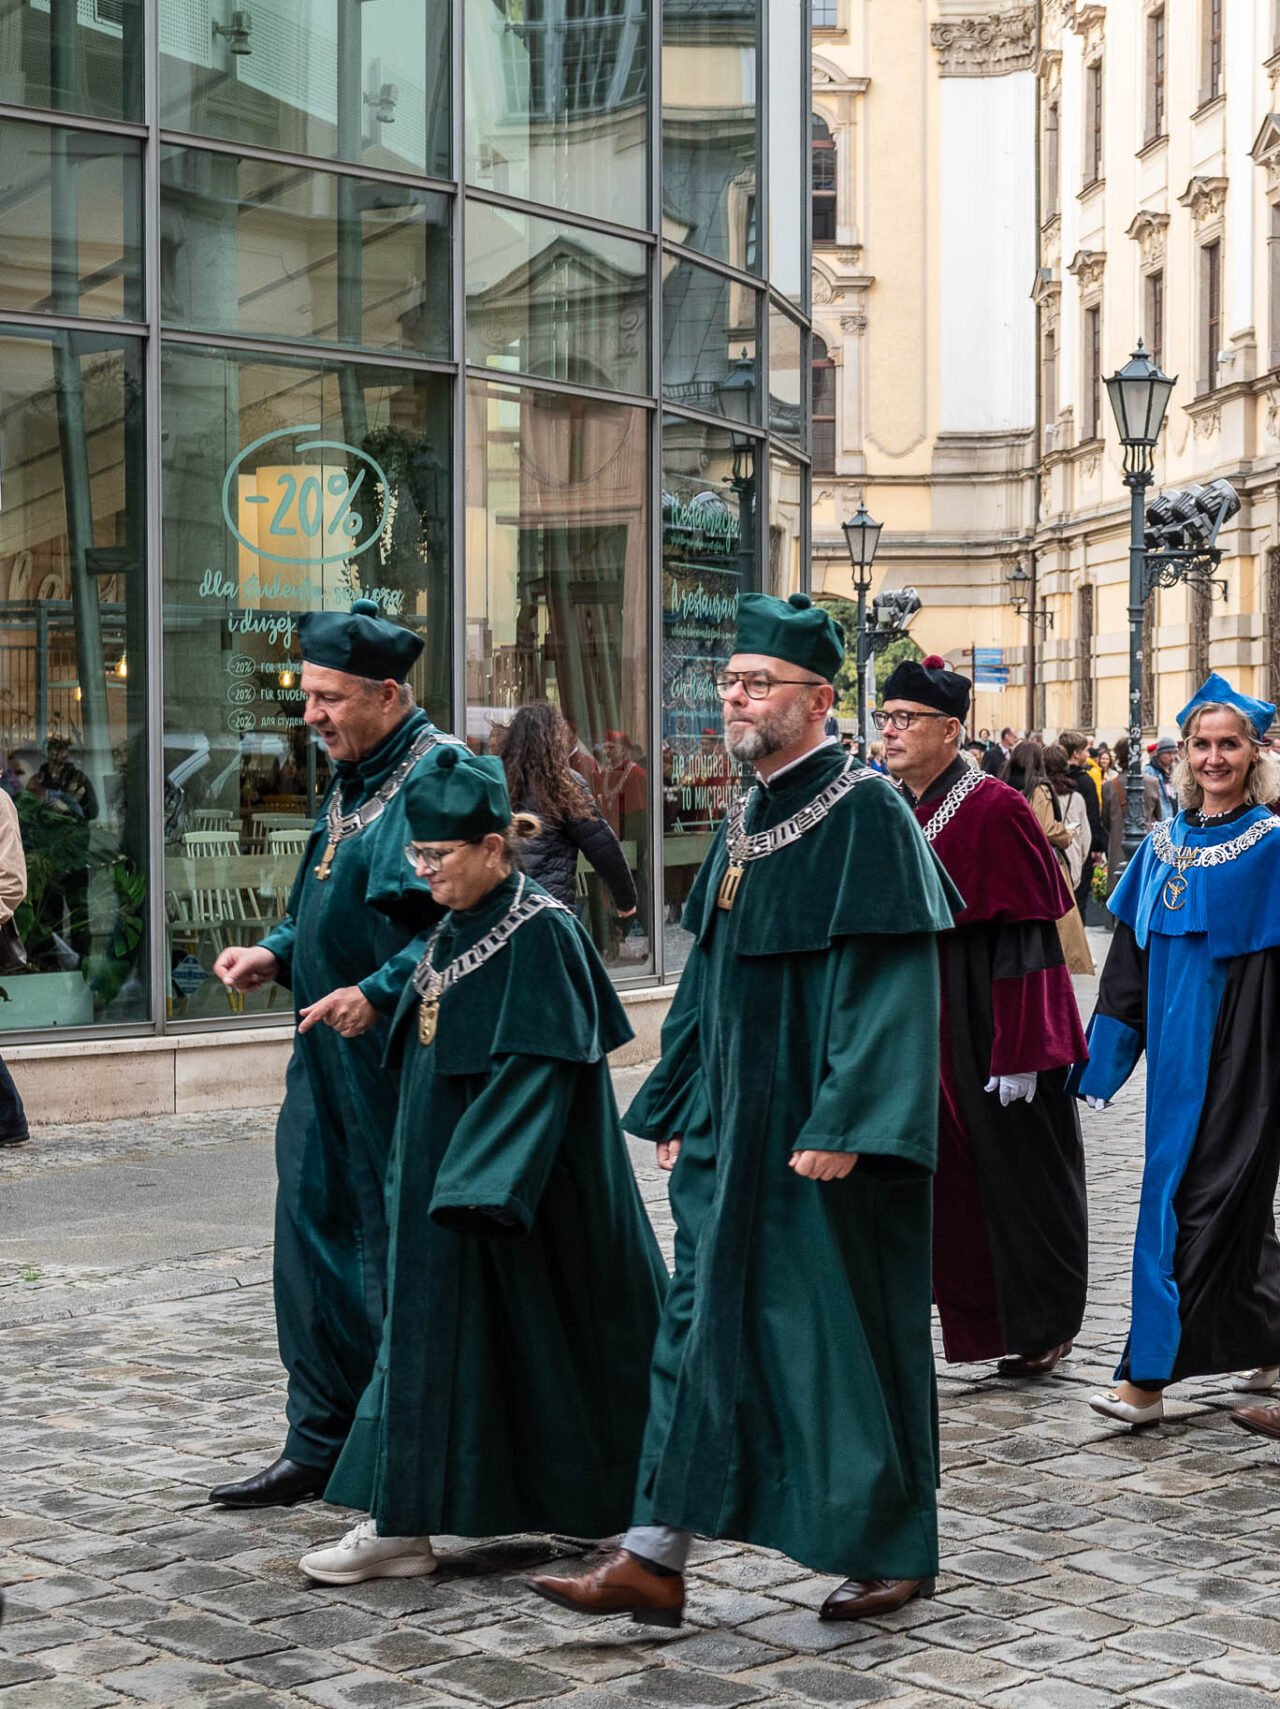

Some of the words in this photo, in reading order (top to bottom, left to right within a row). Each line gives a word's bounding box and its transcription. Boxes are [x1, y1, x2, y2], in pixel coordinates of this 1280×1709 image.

[244, 468, 366, 537] -20%
[199, 568, 239, 598] dla
[228, 611, 239, 633] i
[239, 606, 297, 649] dużej
[231, 660, 252, 673] -20%
[260, 661, 275, 674] FOR
[230, 687, 252, 700] -20%
[230, 714, 253, 729] -20%
[680, 785, 692, 811] то
